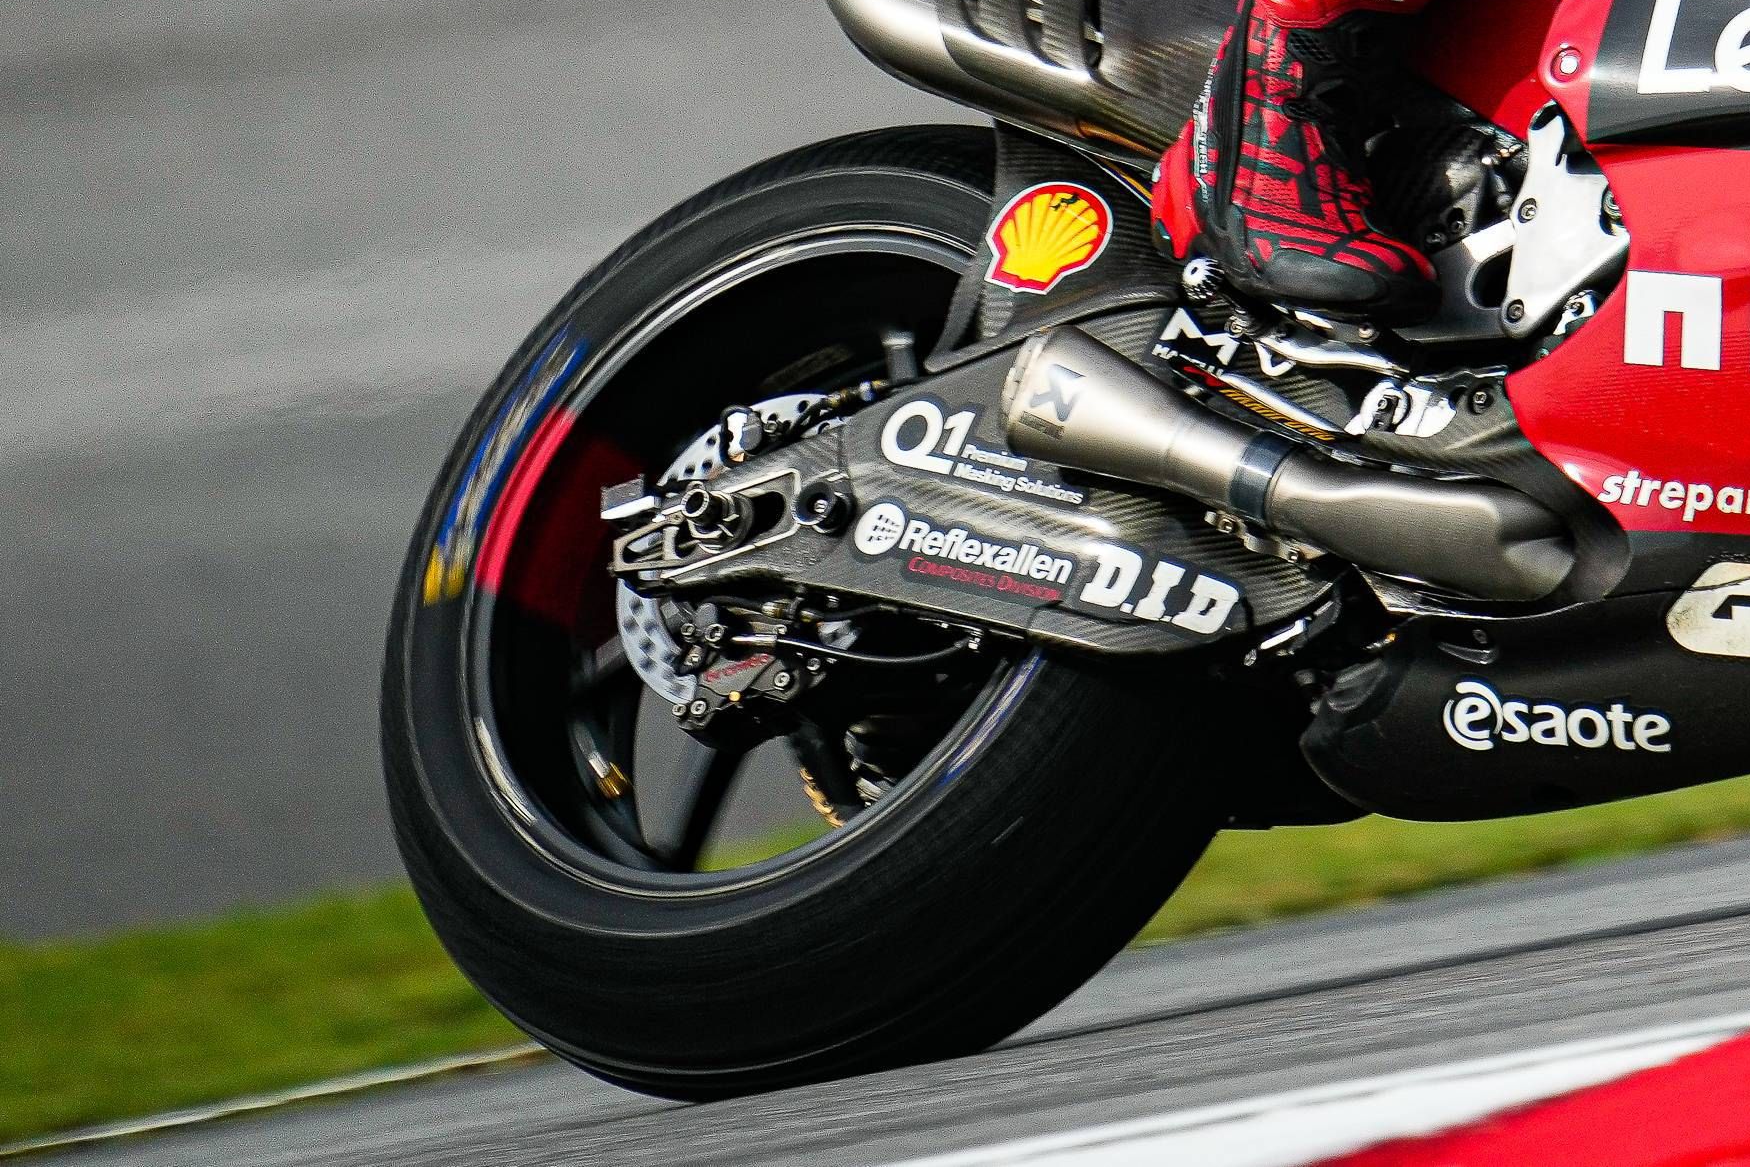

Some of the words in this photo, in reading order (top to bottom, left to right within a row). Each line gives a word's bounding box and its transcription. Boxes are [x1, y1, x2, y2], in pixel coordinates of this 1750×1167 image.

[881, 400, 976, 476] Q1
[953, 462, 1016, 492] Masking
[1014, 476, 1084, 505] Solutions
[898, 519, 1074, 584] Reflexallen
[1443, 681, 1672, 753] esaote
